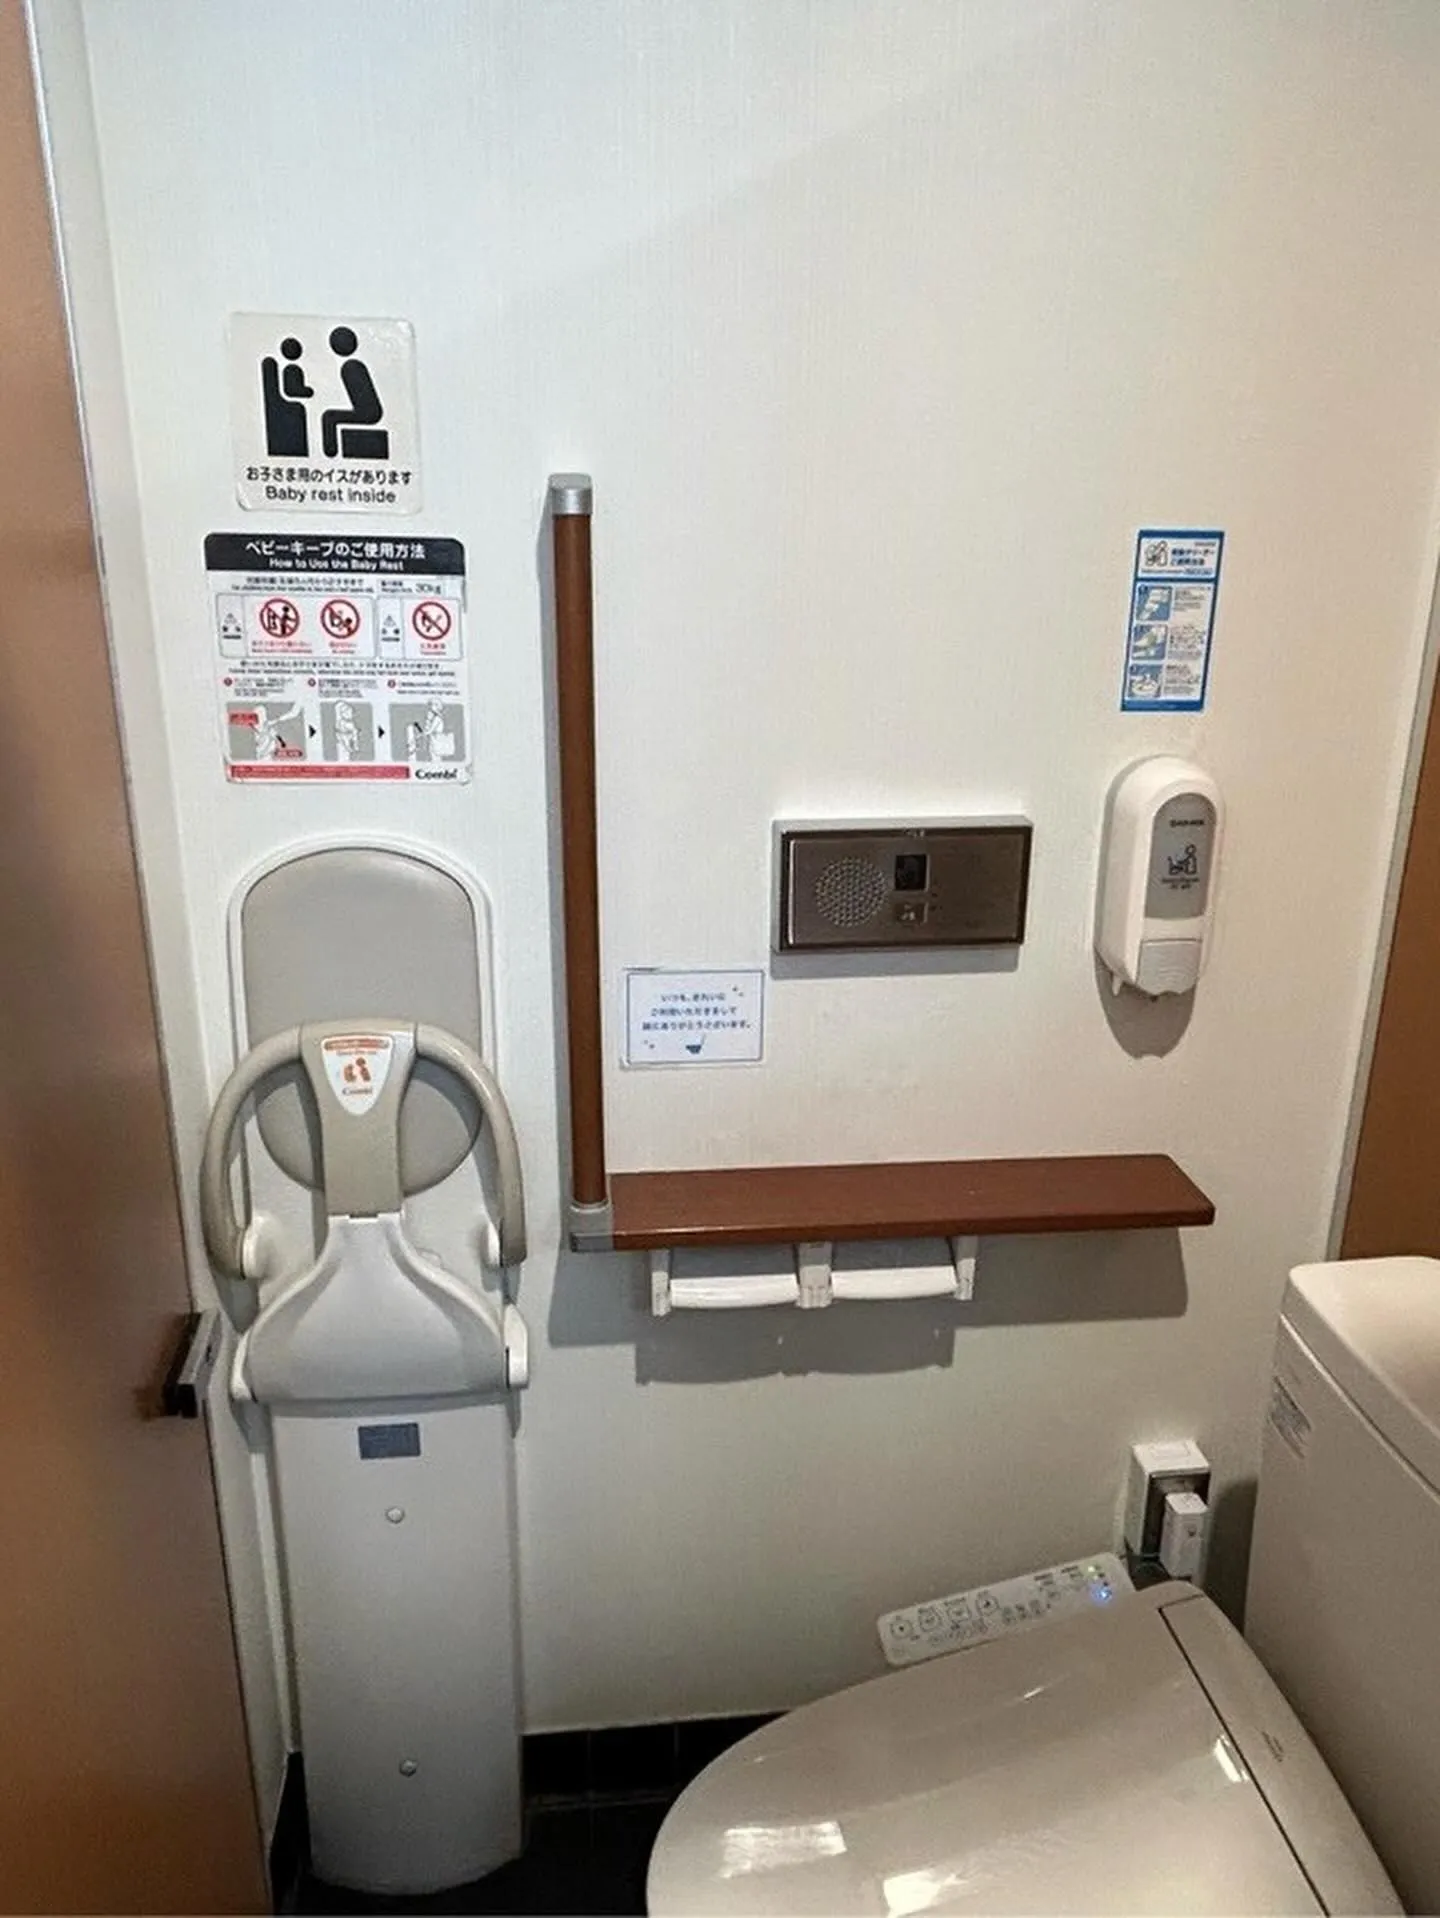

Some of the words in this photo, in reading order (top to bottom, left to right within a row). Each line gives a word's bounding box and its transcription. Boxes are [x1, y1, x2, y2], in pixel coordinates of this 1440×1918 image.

[246, 466, 412, 485] お子さま用のイスがあります
[265, 485, 306, 503] Baby
[311, 488, 343, 502] rest
[348, 488, 396, 503] inside
[245, 540, 425, 559] ベビーキープのご使用方法
[269, 558, 293, 569] How
[295, 558, 307, 569] to
[351, 559, 377, 572] Baby
